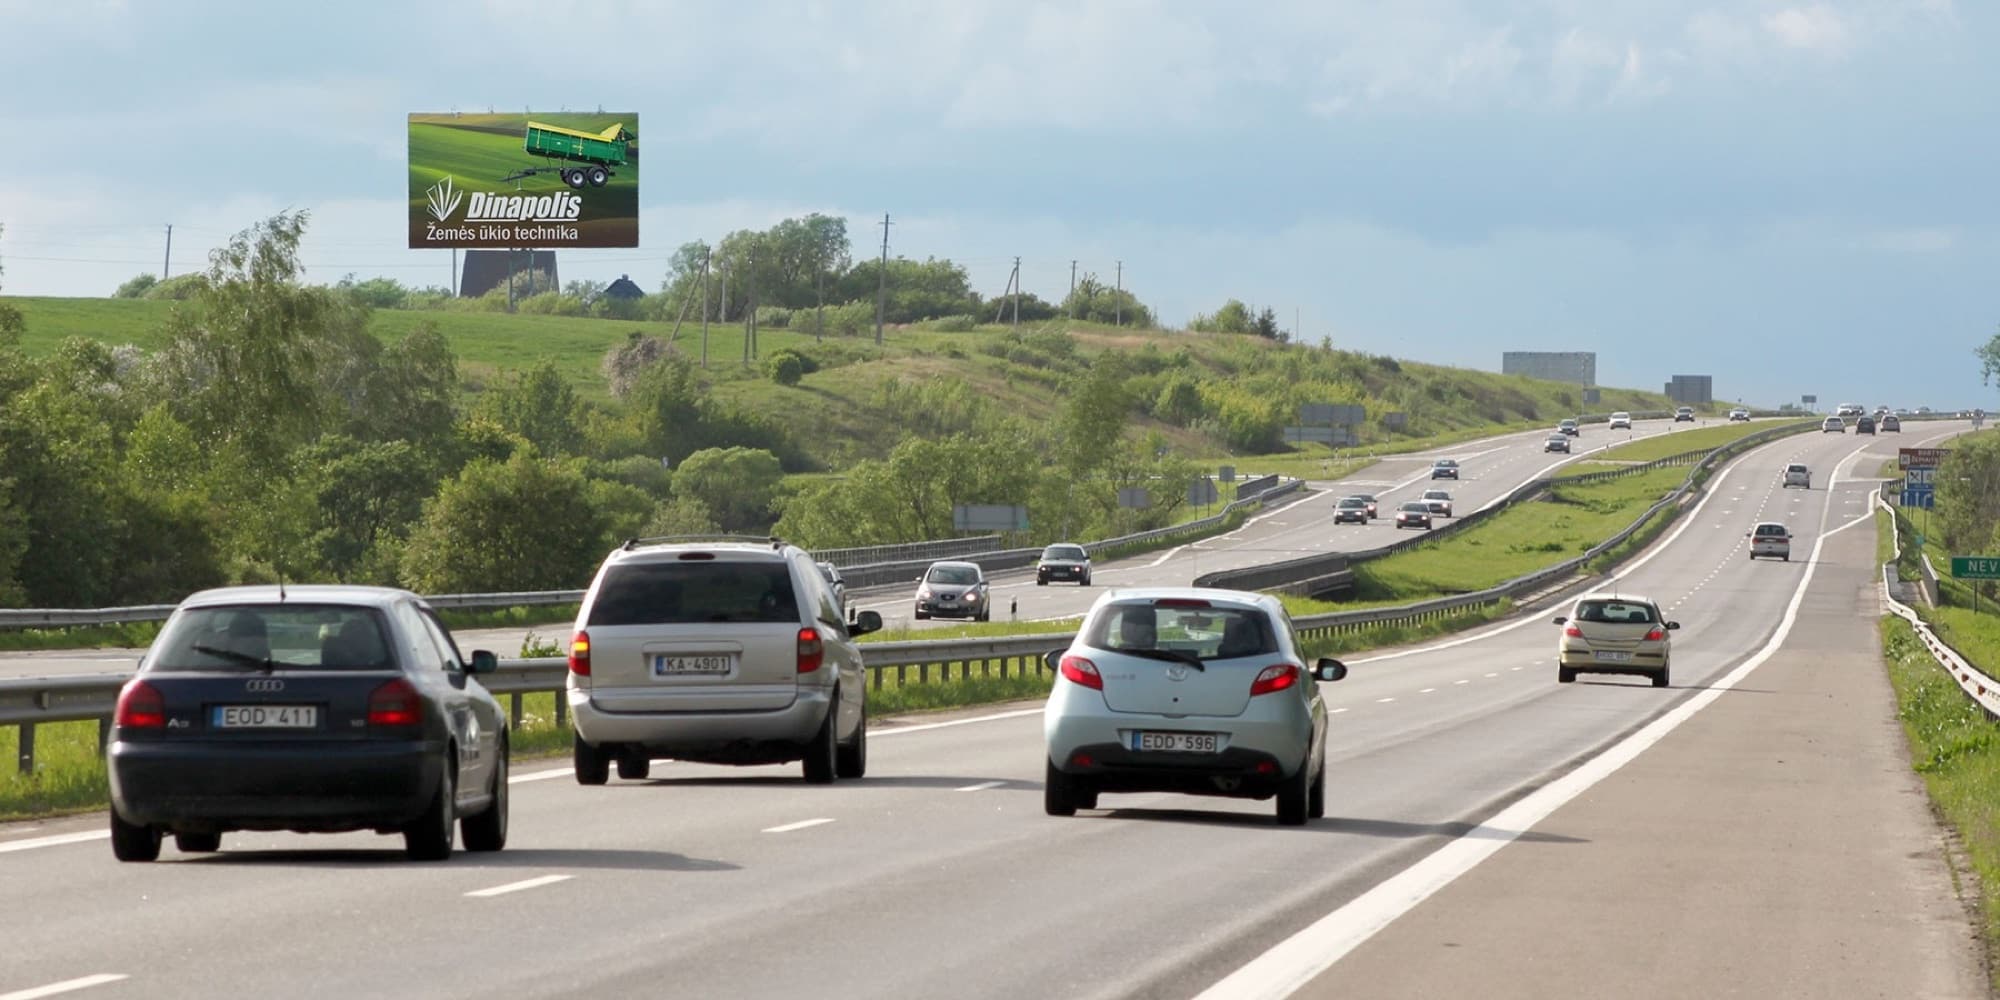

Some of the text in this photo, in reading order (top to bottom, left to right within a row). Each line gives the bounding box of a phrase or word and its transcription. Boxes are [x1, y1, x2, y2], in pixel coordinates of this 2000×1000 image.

[466, 191, 582, 221] Dinapolis
[426, 221, 578, 241] Žemės ūkio technika
[666, 657, 726, 670] KA-4901
[278, 708, 312, 724] 411
[1142, 735, 1213, 750] EDD 596
